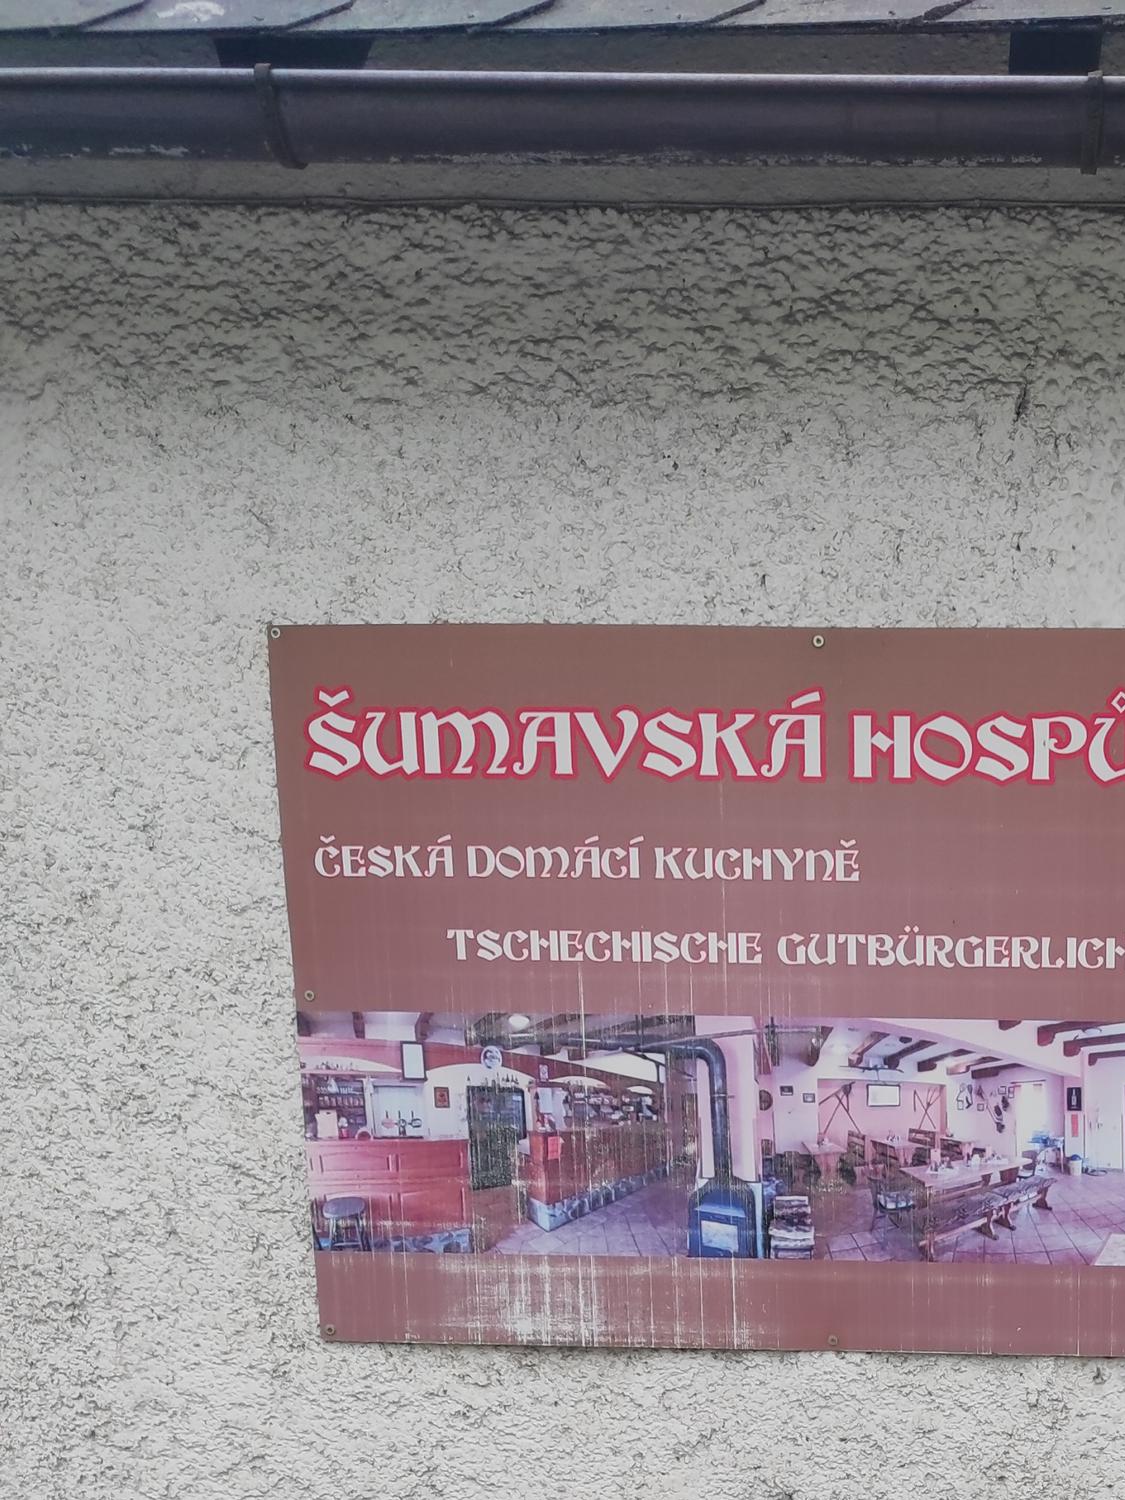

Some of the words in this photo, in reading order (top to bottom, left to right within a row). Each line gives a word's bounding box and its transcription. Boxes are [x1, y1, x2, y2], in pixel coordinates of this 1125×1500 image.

[304, 686, 826, 781] ŠUMAVSKÁ
[314, 834, 454, 879] ČESKÁ
[467, 835, 645, 880] DOMÁCÍ
[654, 839, 861, 882] KUCHYNĚ
[446, 928, 763, 965] TSCHECHISCHE
